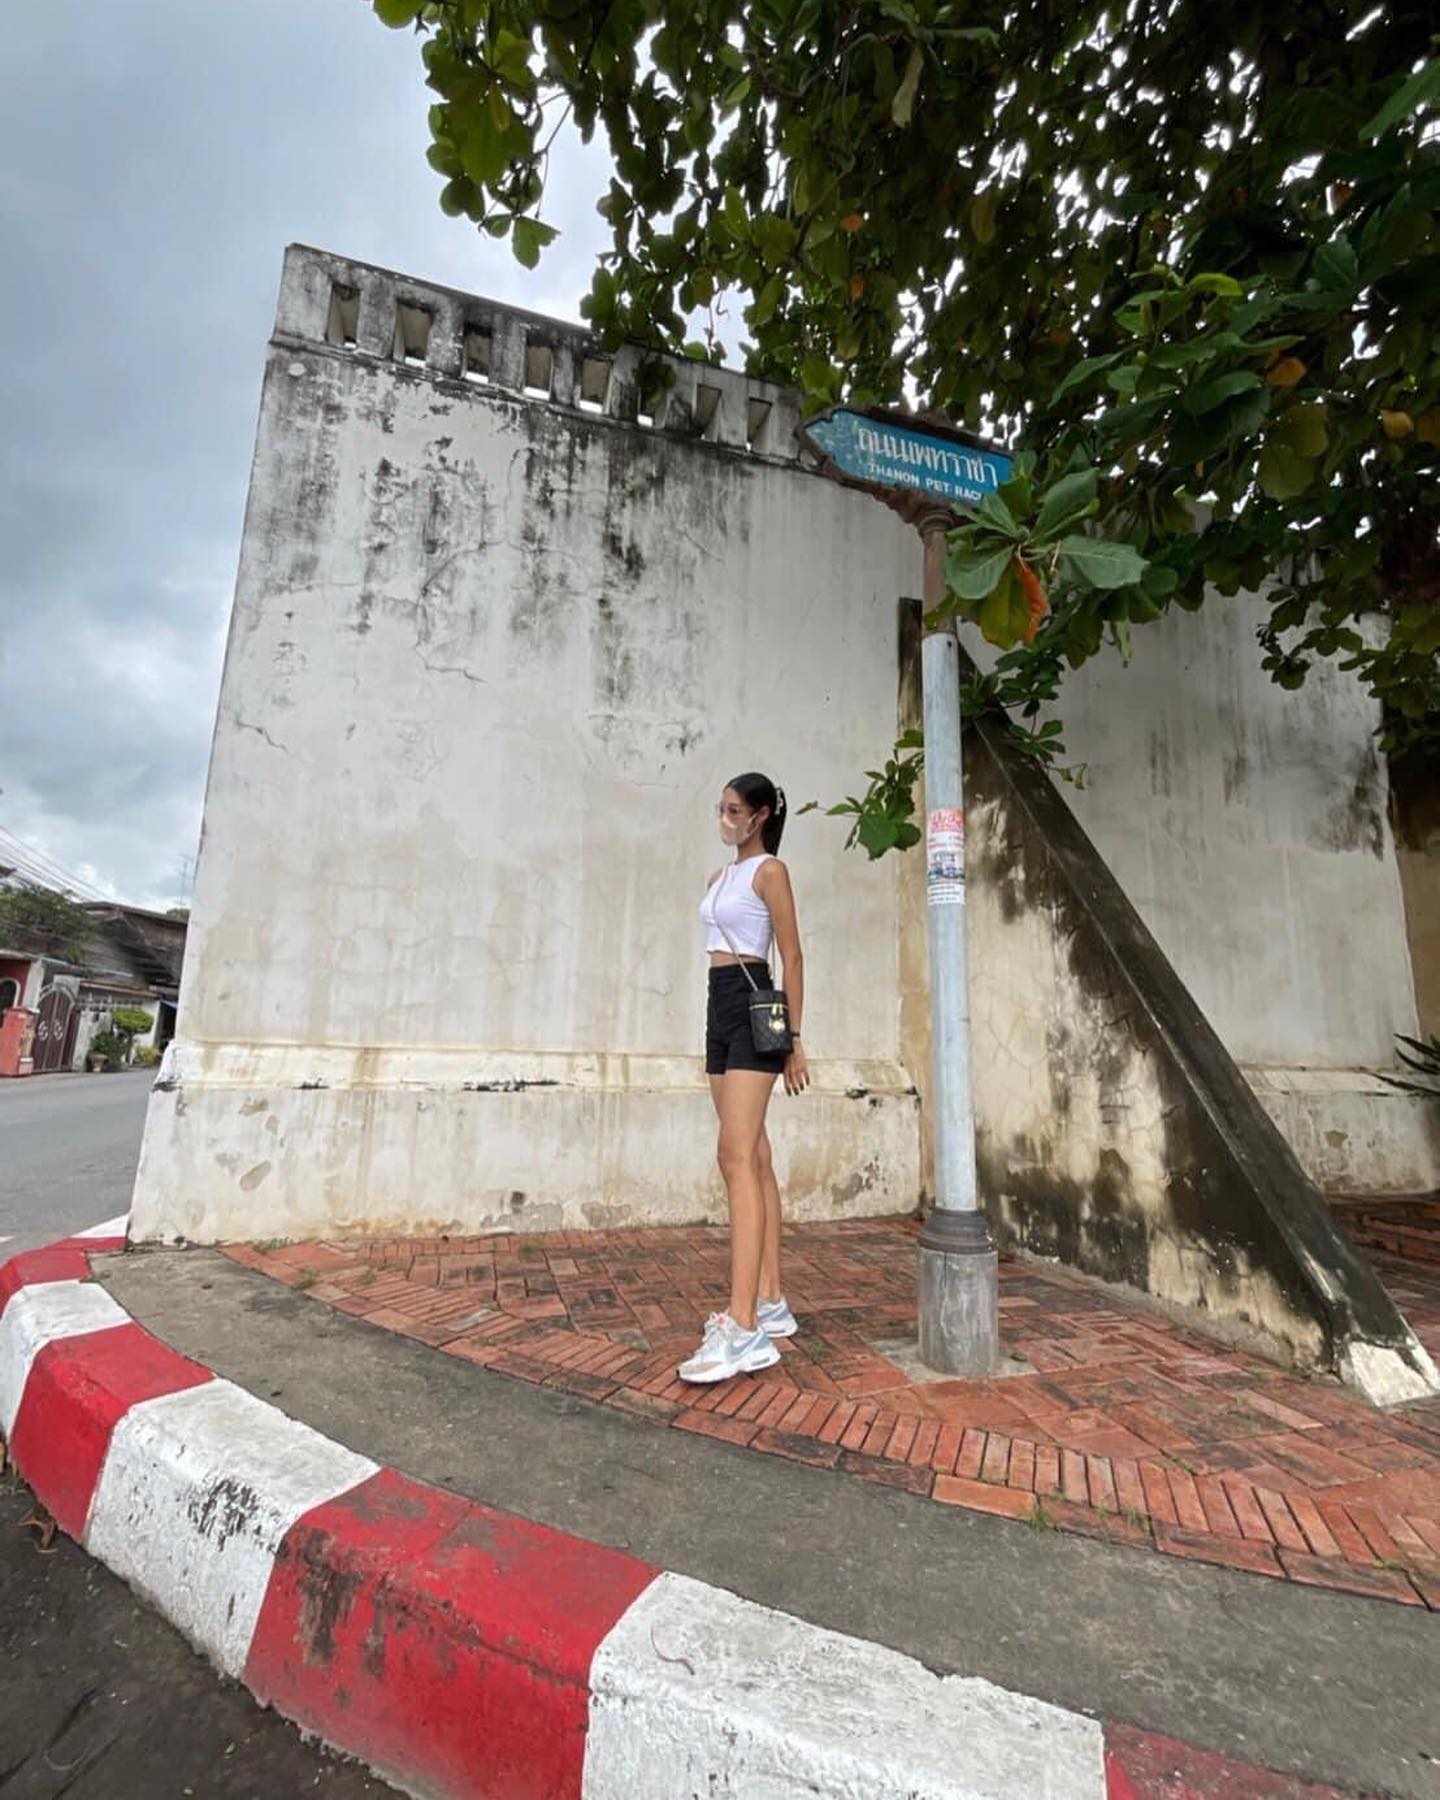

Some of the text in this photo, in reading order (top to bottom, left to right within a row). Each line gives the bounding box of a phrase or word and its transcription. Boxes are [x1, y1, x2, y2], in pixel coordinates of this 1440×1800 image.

[868, 463, 982, 501] THANON PET RAC
